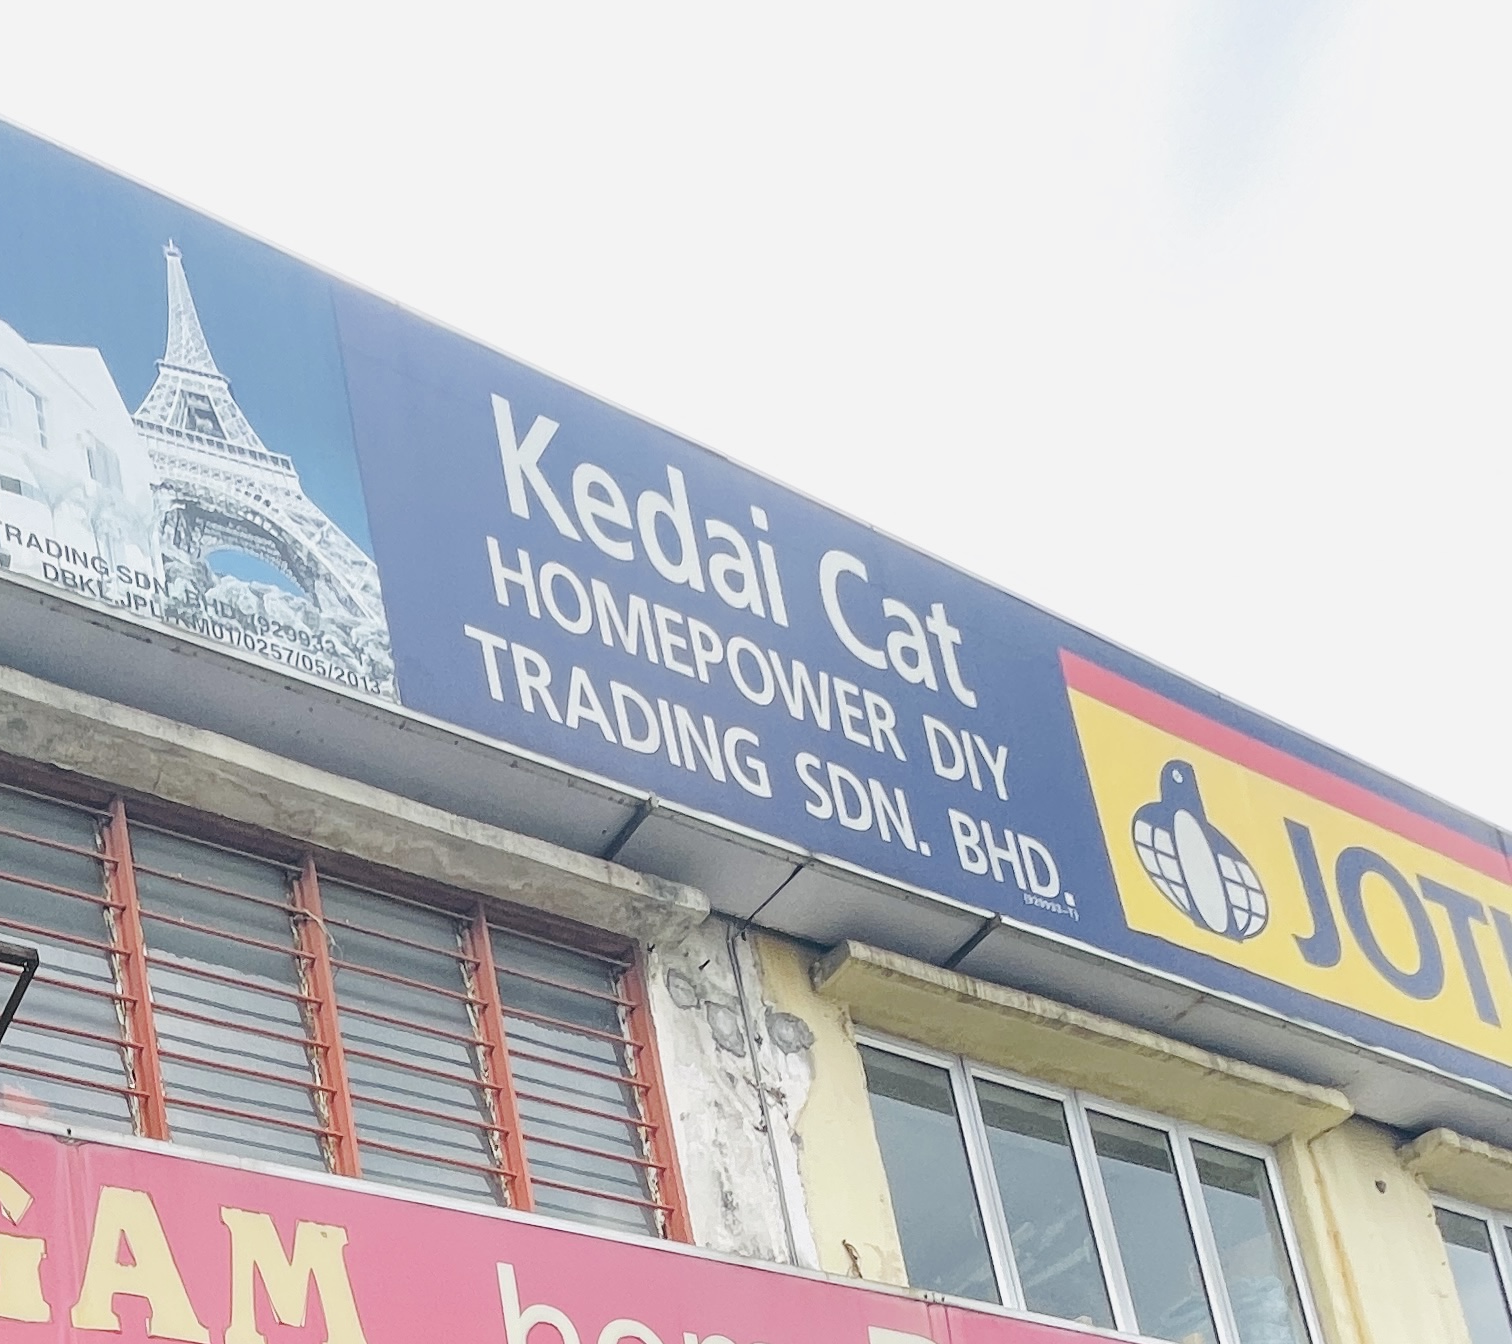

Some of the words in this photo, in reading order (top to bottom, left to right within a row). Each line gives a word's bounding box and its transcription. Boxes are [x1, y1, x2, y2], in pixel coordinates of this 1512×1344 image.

[486, 535, 908, 761] HOMEPOWER
[923, 713, 1010, 801] DIY
[491, 391, 789, 628] Kedai
[818, 548, 977, 708] Cat
[463, 623, 773, 799] TRADING
[794, 751, 932, 857] SDN.
[947, 810, 1077, 908] BHD.
